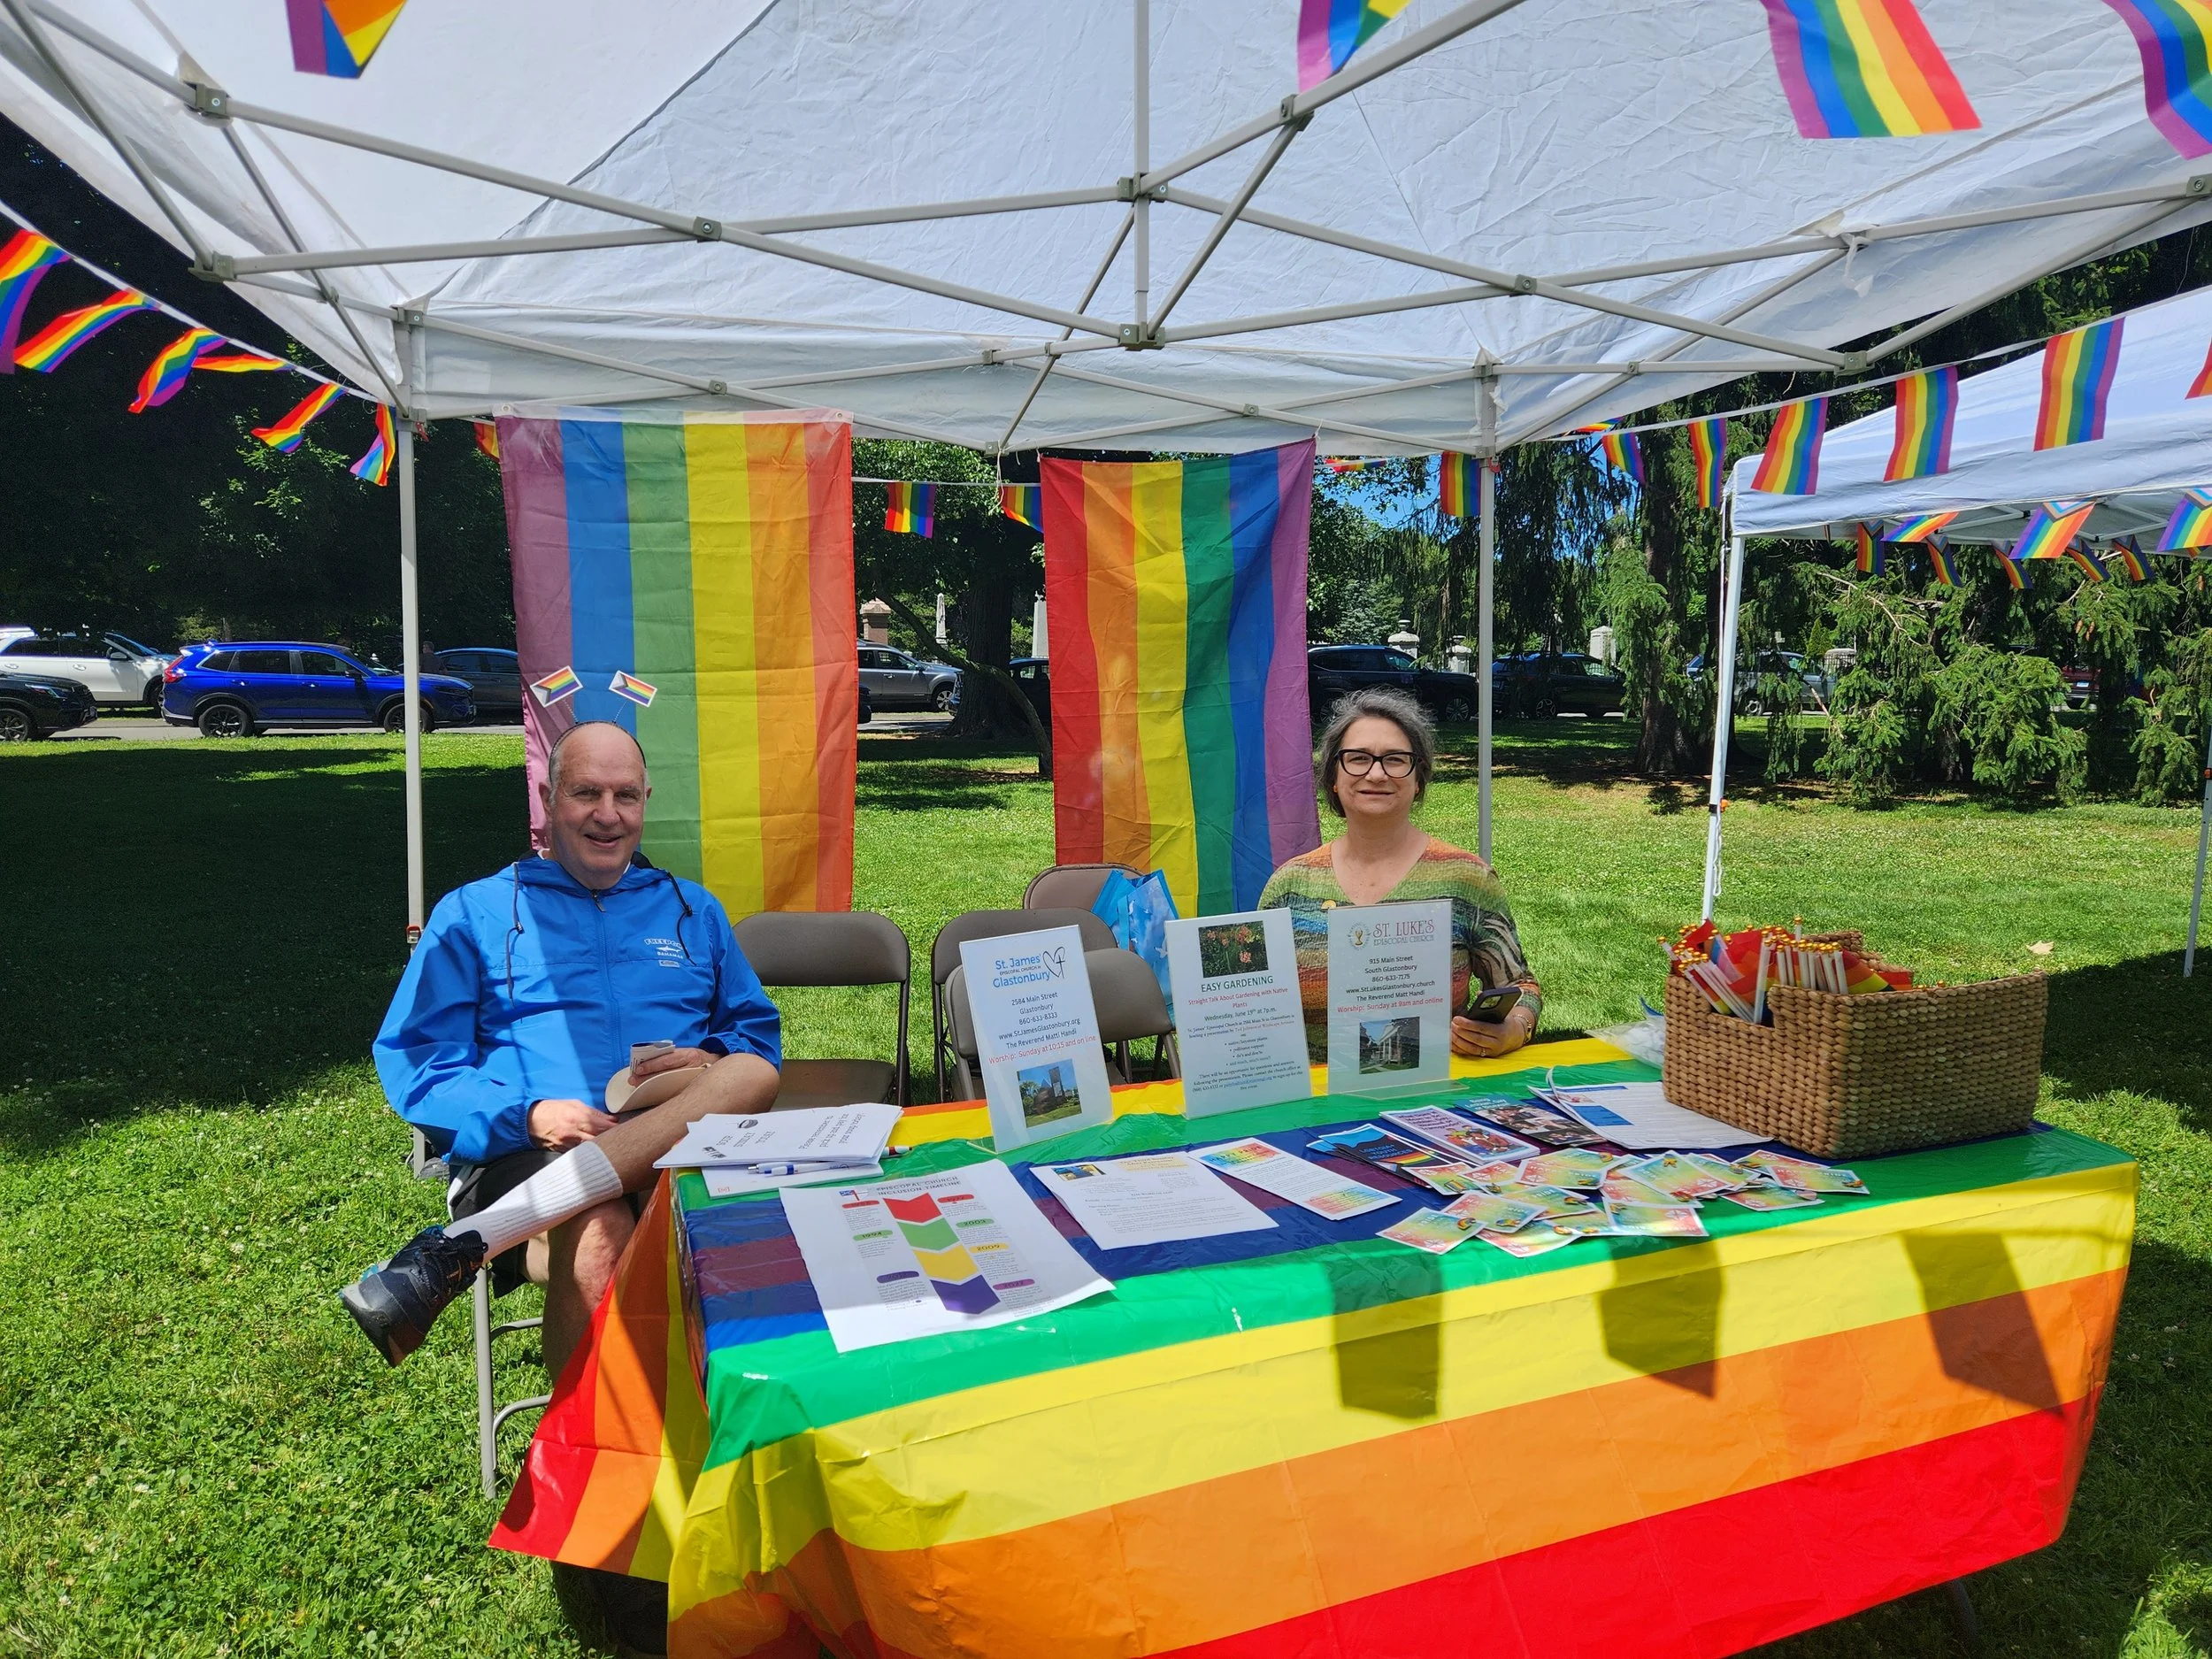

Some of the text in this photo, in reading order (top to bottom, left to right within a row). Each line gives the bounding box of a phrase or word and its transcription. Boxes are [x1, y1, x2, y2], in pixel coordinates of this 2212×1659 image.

[1373, 923, 1391, 938] ST.
[1396, 919, 1434, 936] LUKE'S
[995, 959, 1008, 970] St.
[993, 972, 1050, 988] Glastonbury
[1202, 976, 1273, 992] EASY GARDENING
[1346, 980, 1435, 994] www.StLukesGlastonbury.church
[1026, 995, 1040, 1003] Main
[1041, 992, 1057, 1001] Street
[1188, 996, 1208, 1005] Straight
[1235, 991, 1260, 1000] Gardening
[1020, 1003, 1053, 1015] Glastonbury
[1019, 1012, 1057, 1025] 860-633-8333
[999, 1018, 1080, 1040] www.StJamesGlastonbury.org
[1018, 1035, 1045, 1047] Reverend
[989, 1053, 1016, 1064] Worship:
[1018, 1047, 1041, 1057] Sunday
[1209, 1152, 1236, 1162] HAPPY
[876, 1181, 920, 1191] EPISCOPAL
[878, 1181, 962, 1195] INCLUSION TIMELINE
